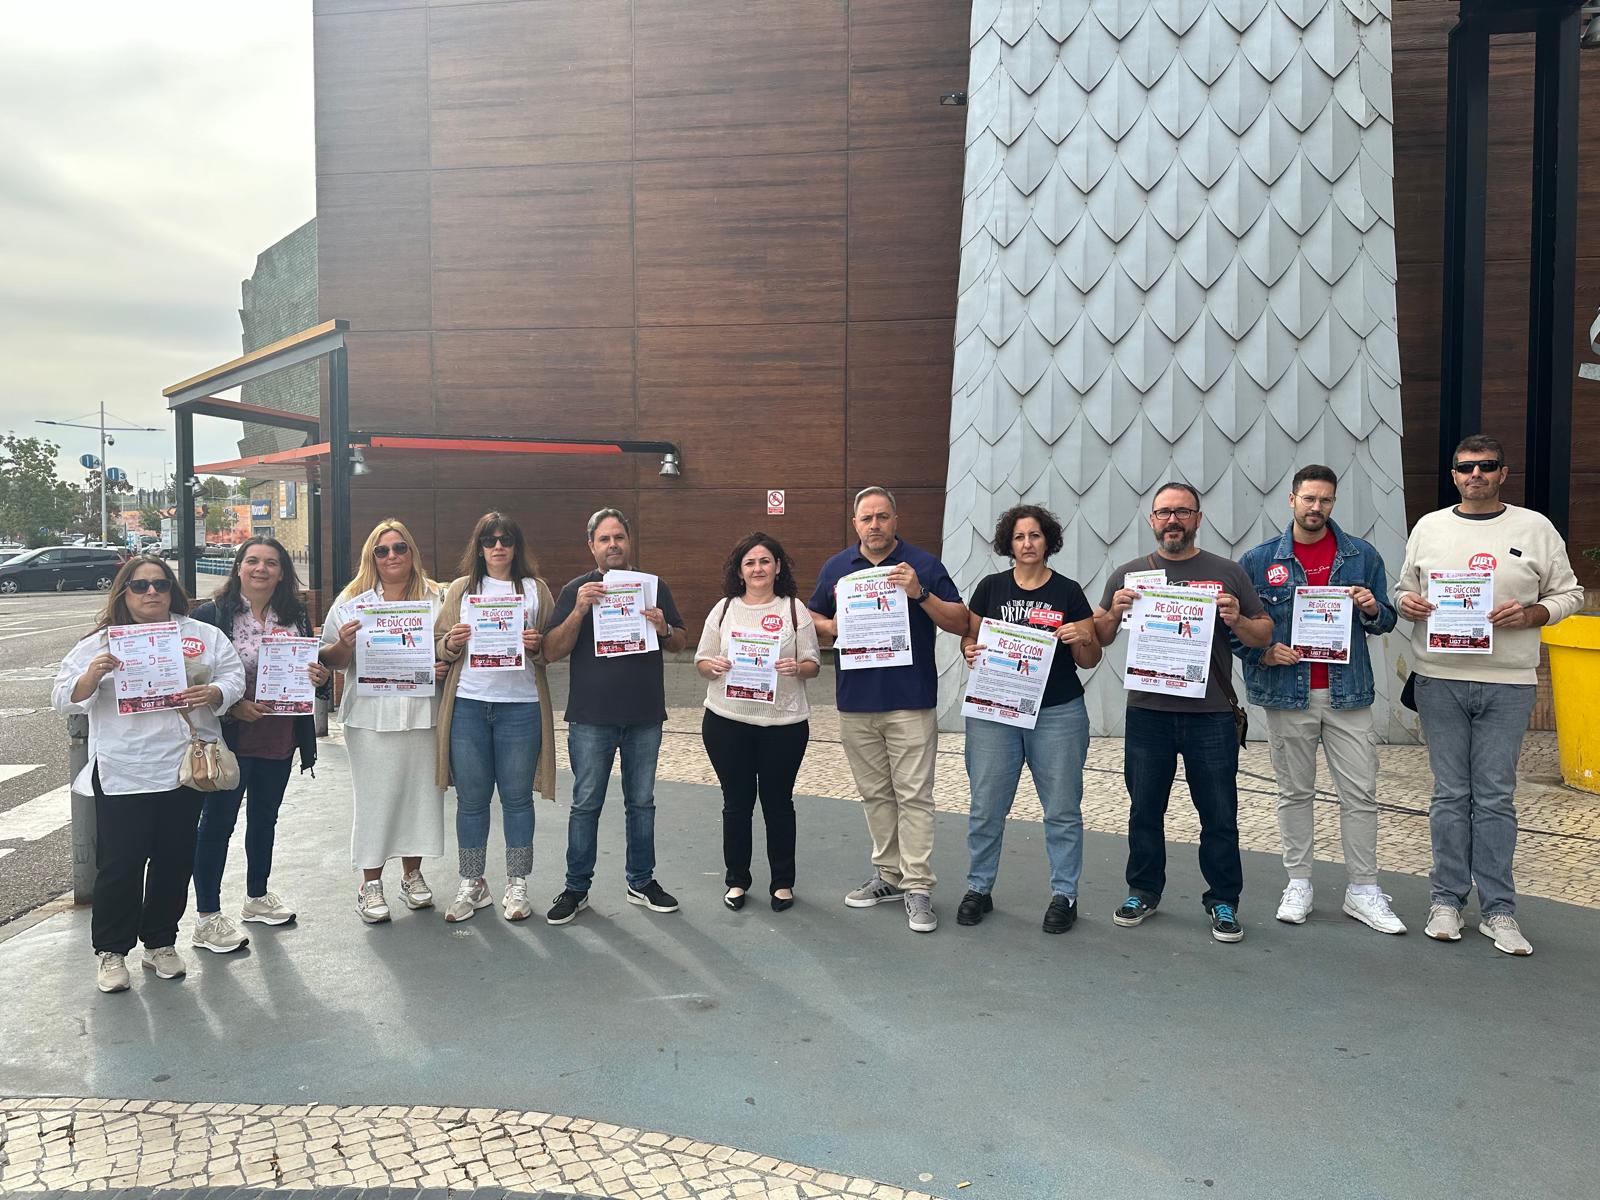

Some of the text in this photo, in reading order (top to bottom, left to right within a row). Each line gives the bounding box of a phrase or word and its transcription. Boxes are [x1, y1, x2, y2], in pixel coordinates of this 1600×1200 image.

[1472, 556, 1494, 565] UGT
[1268, 565, 1285, 576] UGT
[1155, 602, 1204, 616] REDUCCIÓN
[1031, 611, 1062, 620] CCOO
[377, 616, 422, 627] REDUCCIÓN
[149, 636, 154, 646] 4
[182, 639, 202, 651] UGT
[292, 646, 296, 656] 4
[998, 638, 1044, 656] REDUCCIÓN
[149, 655, 156, 665] 5
[119, 662, 125, 671] 2
[263, 665, 268, 674] 2
[288, 664, 294, 673] 5
[121, 680, 128, 691] 3
[261, 684, 266, 693] 3
